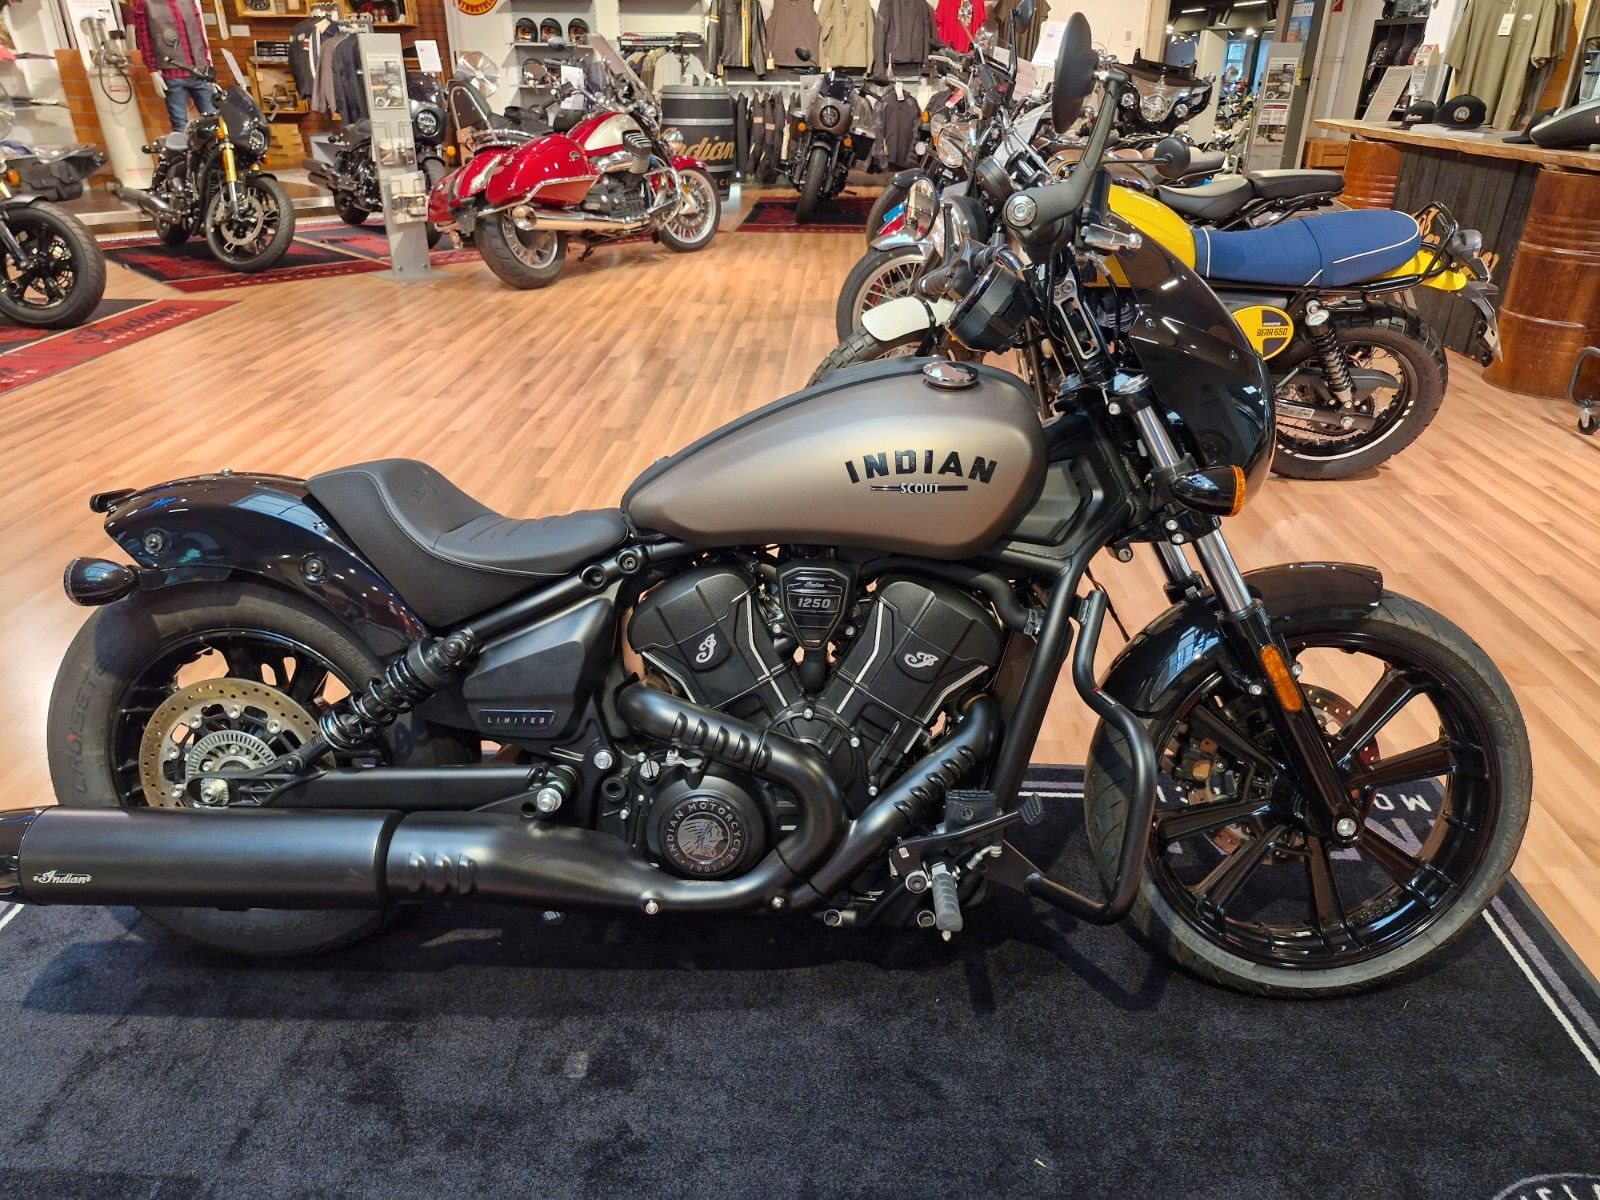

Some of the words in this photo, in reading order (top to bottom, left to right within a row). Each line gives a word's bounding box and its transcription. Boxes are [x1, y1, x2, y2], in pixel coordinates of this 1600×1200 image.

[1257, 328, 1273, 337] BEAR
[1273, 327, 1289, 336] 650
[845, 449, 998, 484] INDIAN
[900, 482, 939, 494] SCOUT
[797, 597, 832, 609] 1250
[487, 716, 545, 724] LIMITED
[666, 810, 685, 858] INDIAN
[687, 801, 742, 862] MOTORCYCLE
[36, 869, 89, 884] Indian
